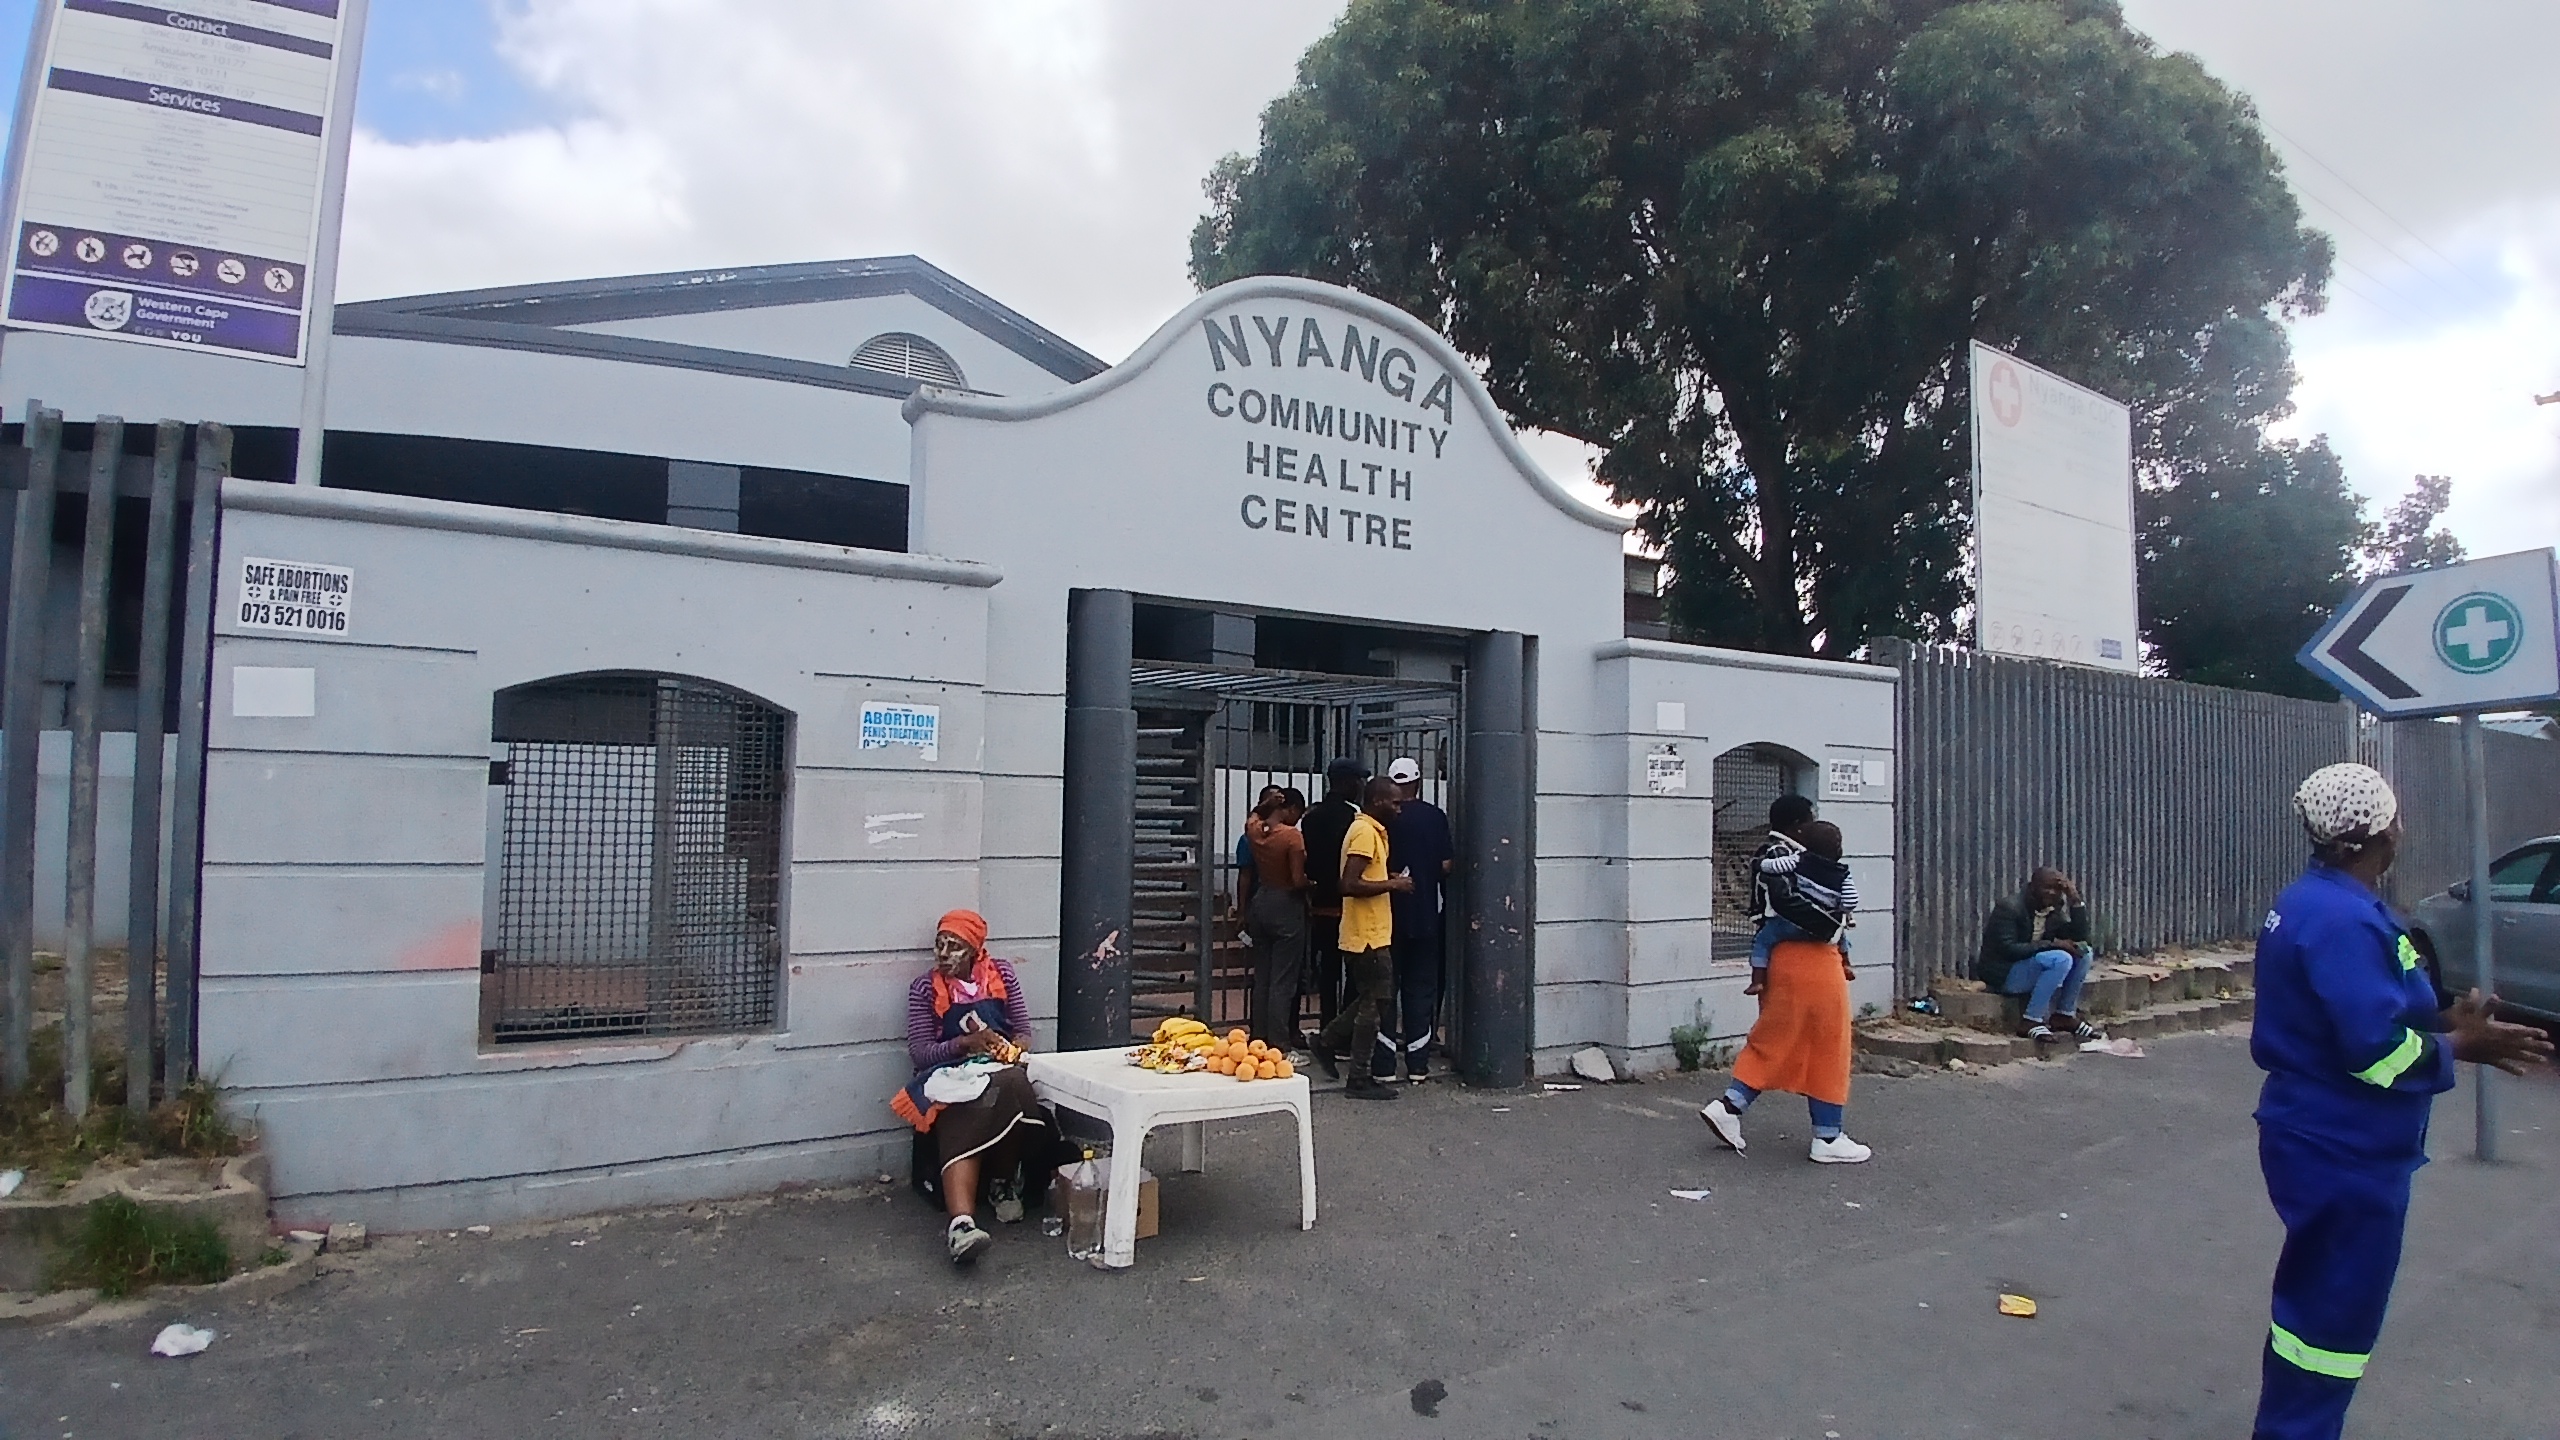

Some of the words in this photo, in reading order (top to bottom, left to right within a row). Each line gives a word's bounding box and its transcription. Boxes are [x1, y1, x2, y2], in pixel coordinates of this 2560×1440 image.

[166, 12, 228, 36] Contact
[149, 86, 221, 114] Services
[135, 307, 216, 329] Government
[137, 296, 193, 315] Western
[194, 304, 229, 320] Cape
[170, 329, 202, 343] YOU
[1202, 315, 1453, 425] NYANGA
[1207, 382, 1448, 459] COMMUNITY
[1246, 441, 1412, 501] HEALTH
[1240, 494, 1412, 550] CENTRE
[245, 564, 275, 586] SAFE
[277, 568, 349, 593] ABORTIONS
[269, 588, 275, 600] &
[278, 588, 300, 602] PAIN
[301, 590, 322, 604] FREE
[241, 602, 271, 624] 073
[274, 605, 302, 627] 521
[306, 608, 346, 631] 0016
[864, 711, 935, 728] ABORTION
[889, 727, 934, 740] TREATMENT
